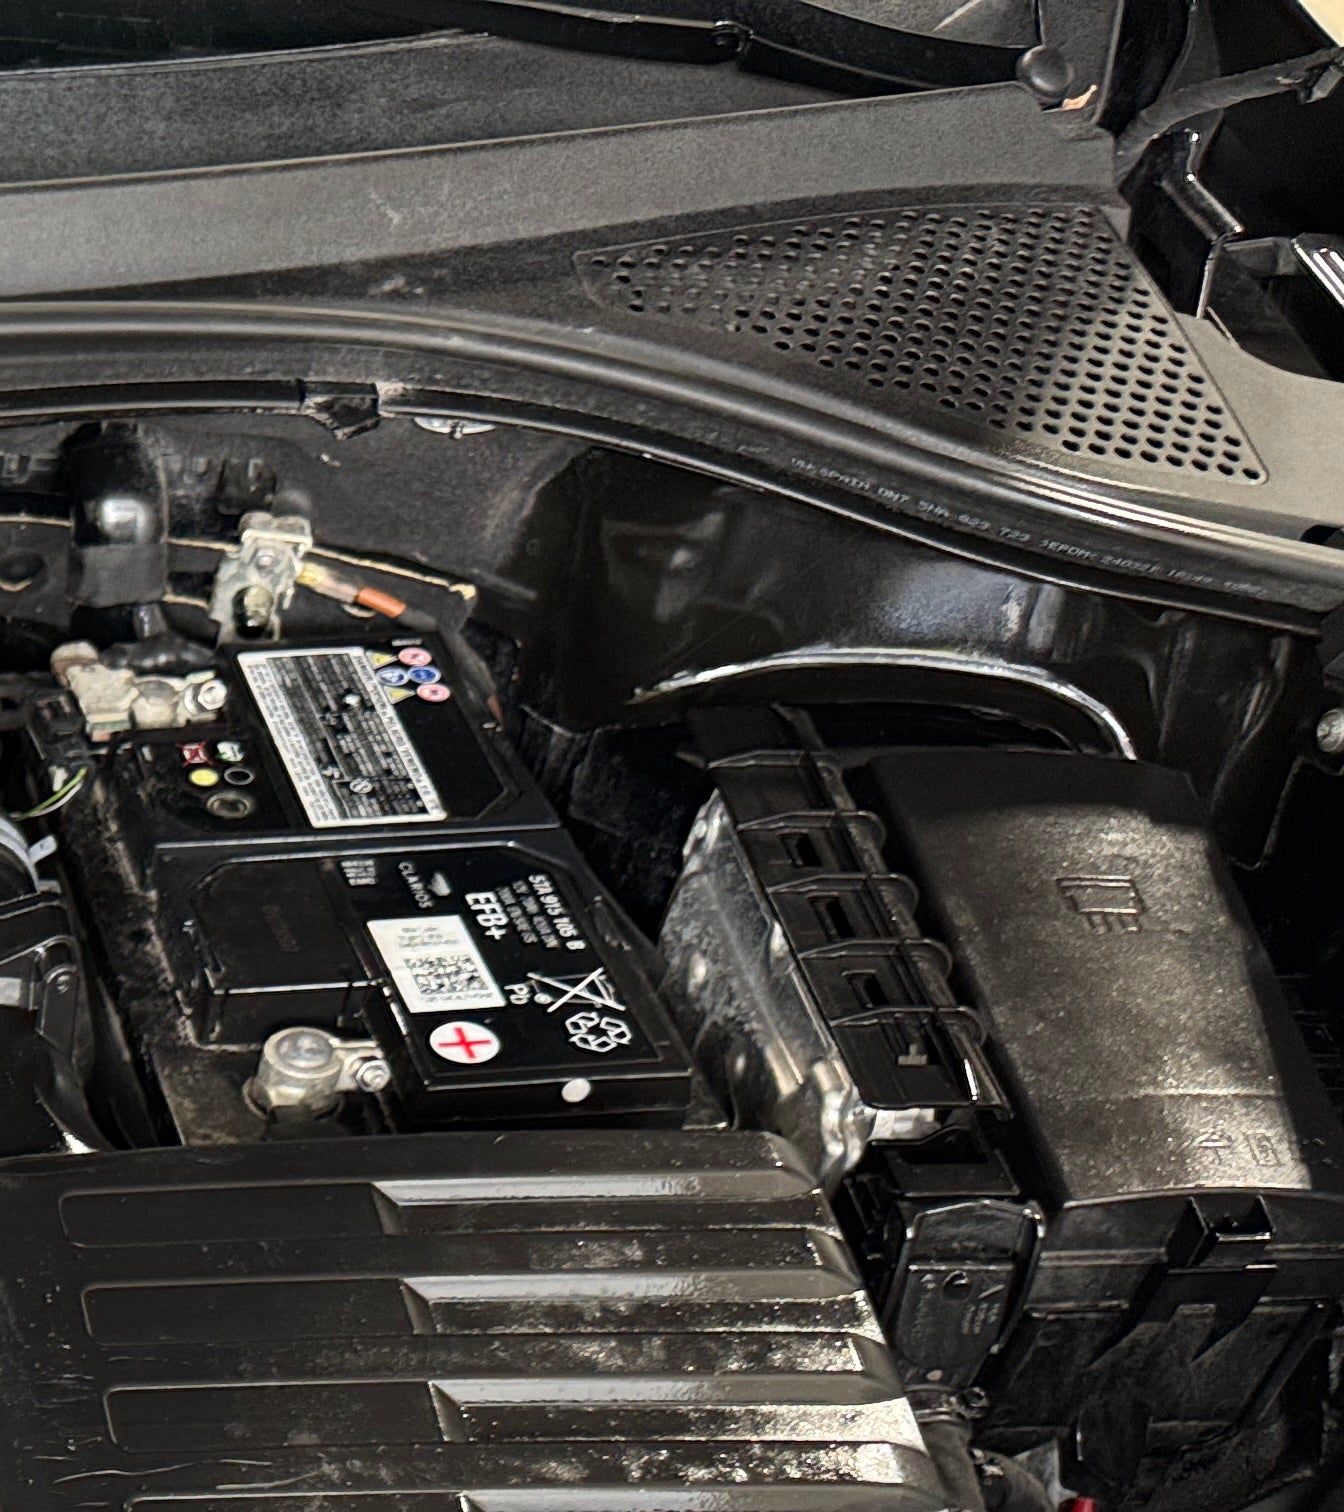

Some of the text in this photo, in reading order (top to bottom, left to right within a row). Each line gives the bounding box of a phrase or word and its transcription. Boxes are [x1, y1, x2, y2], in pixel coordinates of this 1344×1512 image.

[399, 862, 433, 909] CLARIOS
[465, 891, 507, 940] EFB+
[504, 983, 532, 1005] Pb
